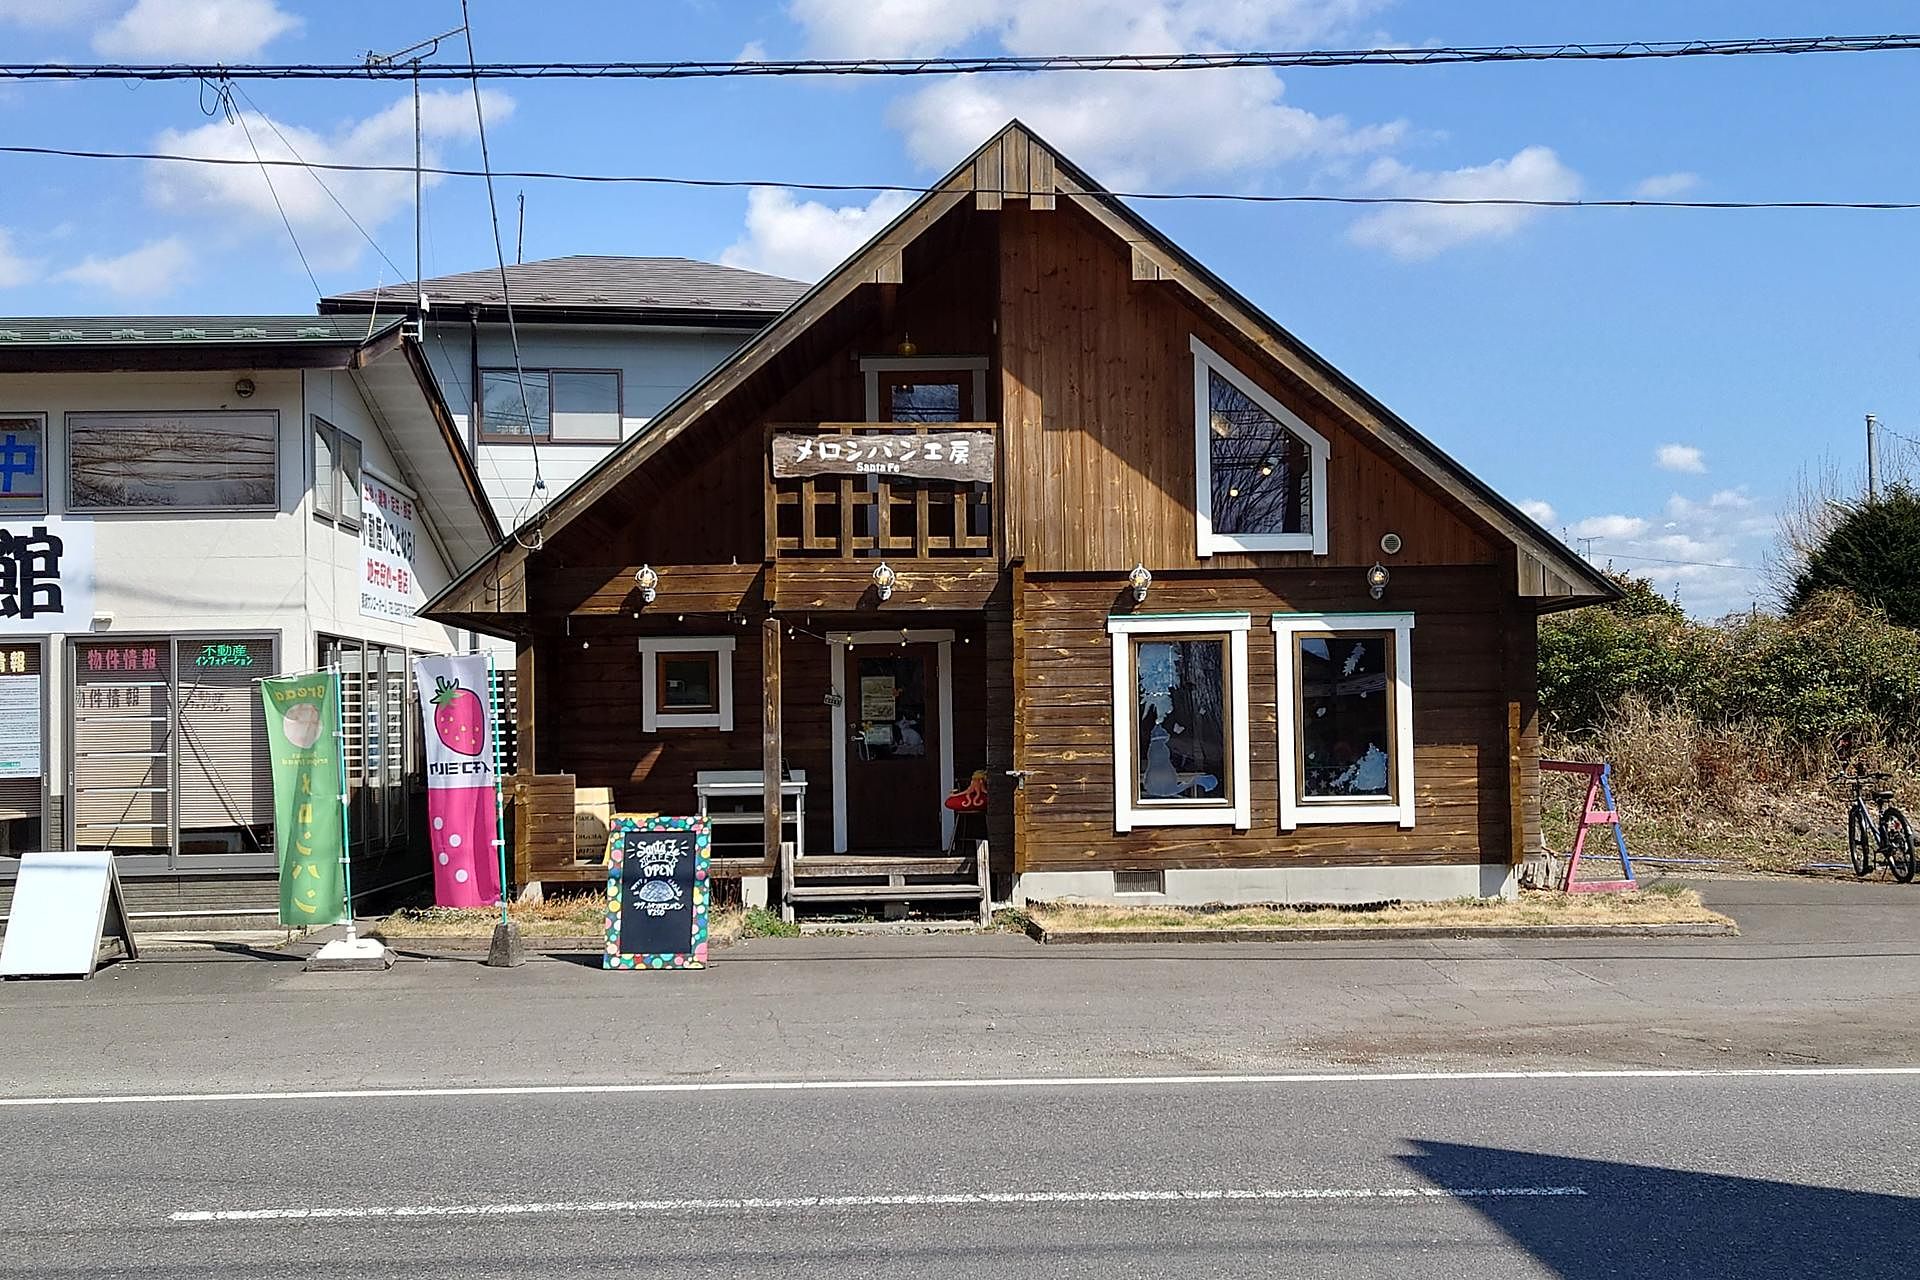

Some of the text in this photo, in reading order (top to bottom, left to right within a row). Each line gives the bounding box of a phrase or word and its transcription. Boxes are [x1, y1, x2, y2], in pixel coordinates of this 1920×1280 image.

[796, 439, 970, 464] メロンパン工房
[856, 462, 900, 472] Santa Fe
[202, 645, 248, 656] 不動産
[87, 648, 157, 670] 物件情報
[195, 656, 253, 666] インフォメーション
[643, 863, 674, 877] OPEN
